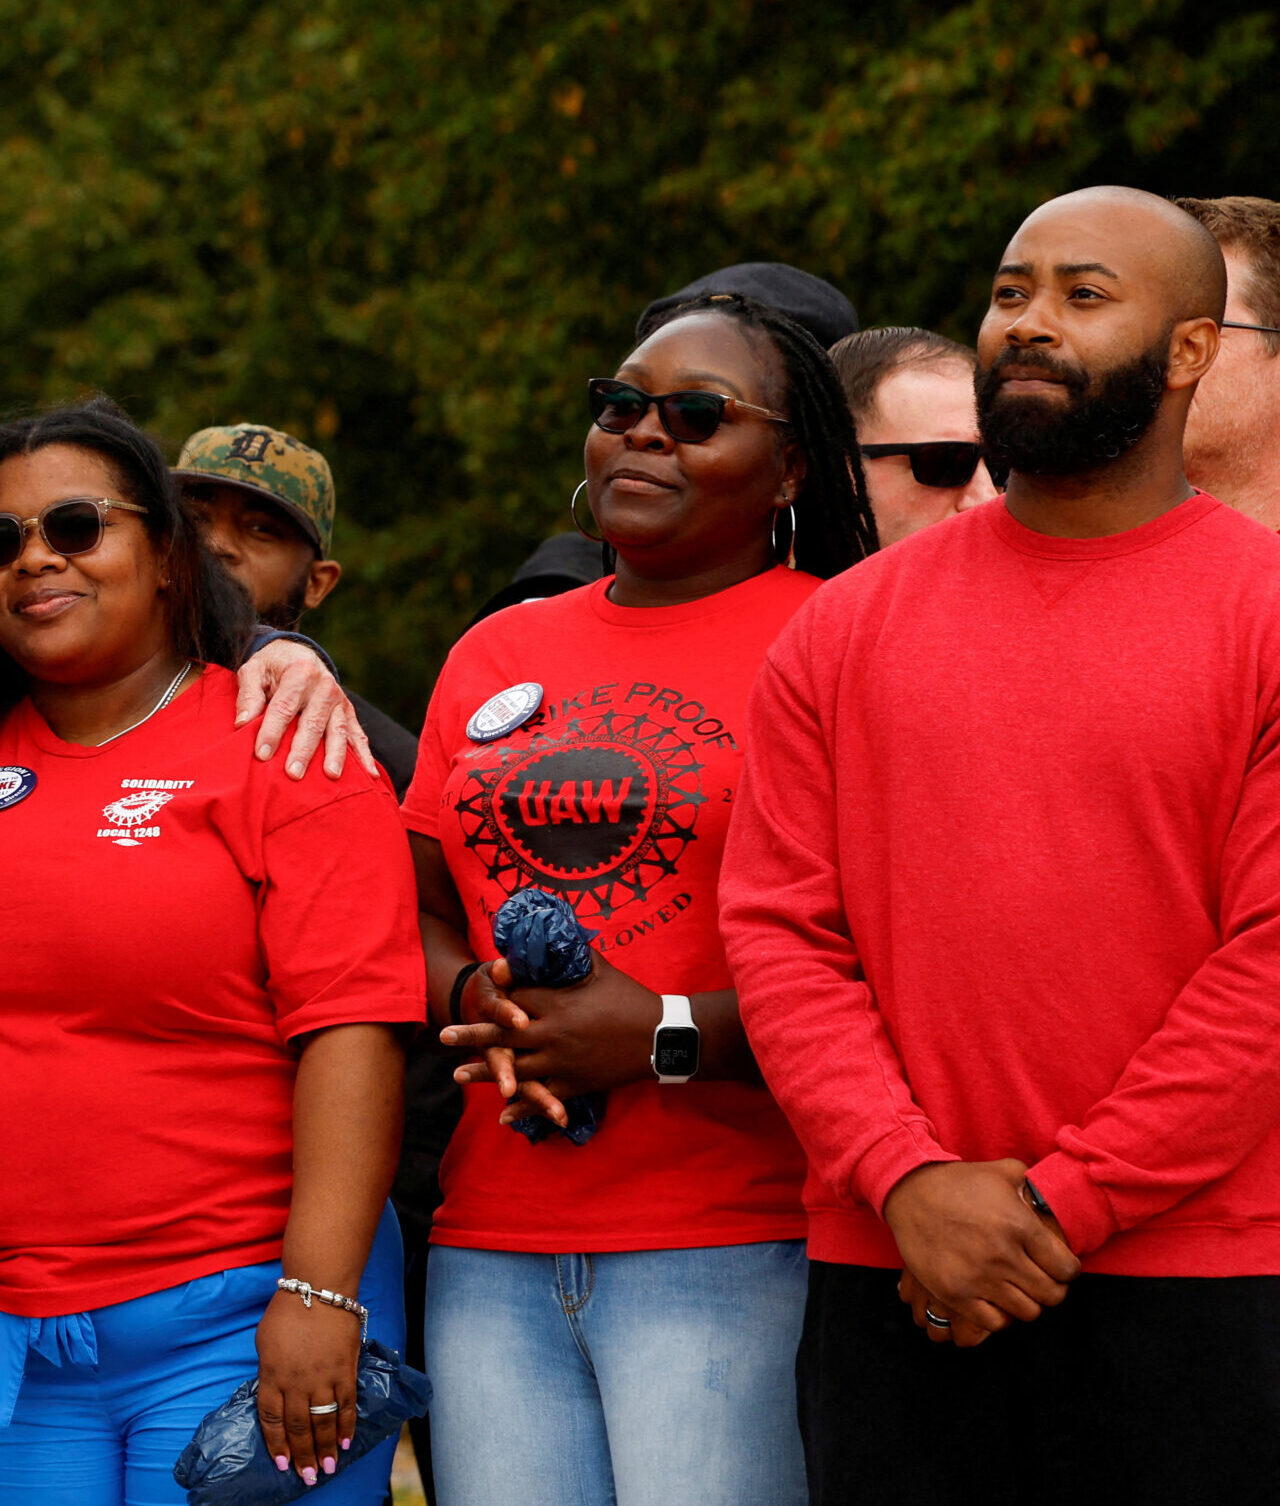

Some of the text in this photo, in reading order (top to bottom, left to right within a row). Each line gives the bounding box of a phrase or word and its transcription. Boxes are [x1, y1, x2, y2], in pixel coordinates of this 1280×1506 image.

[503, 682, 619, 738] RIKE
[624, 682, 738, 750] PROOF
[120, 779, 195, 789] SOLIDARITY
[518, 776, 633, 826] UAW
[96, 829, 131, 838] LOCAL
[600, 892, 692, 953] LOWED
